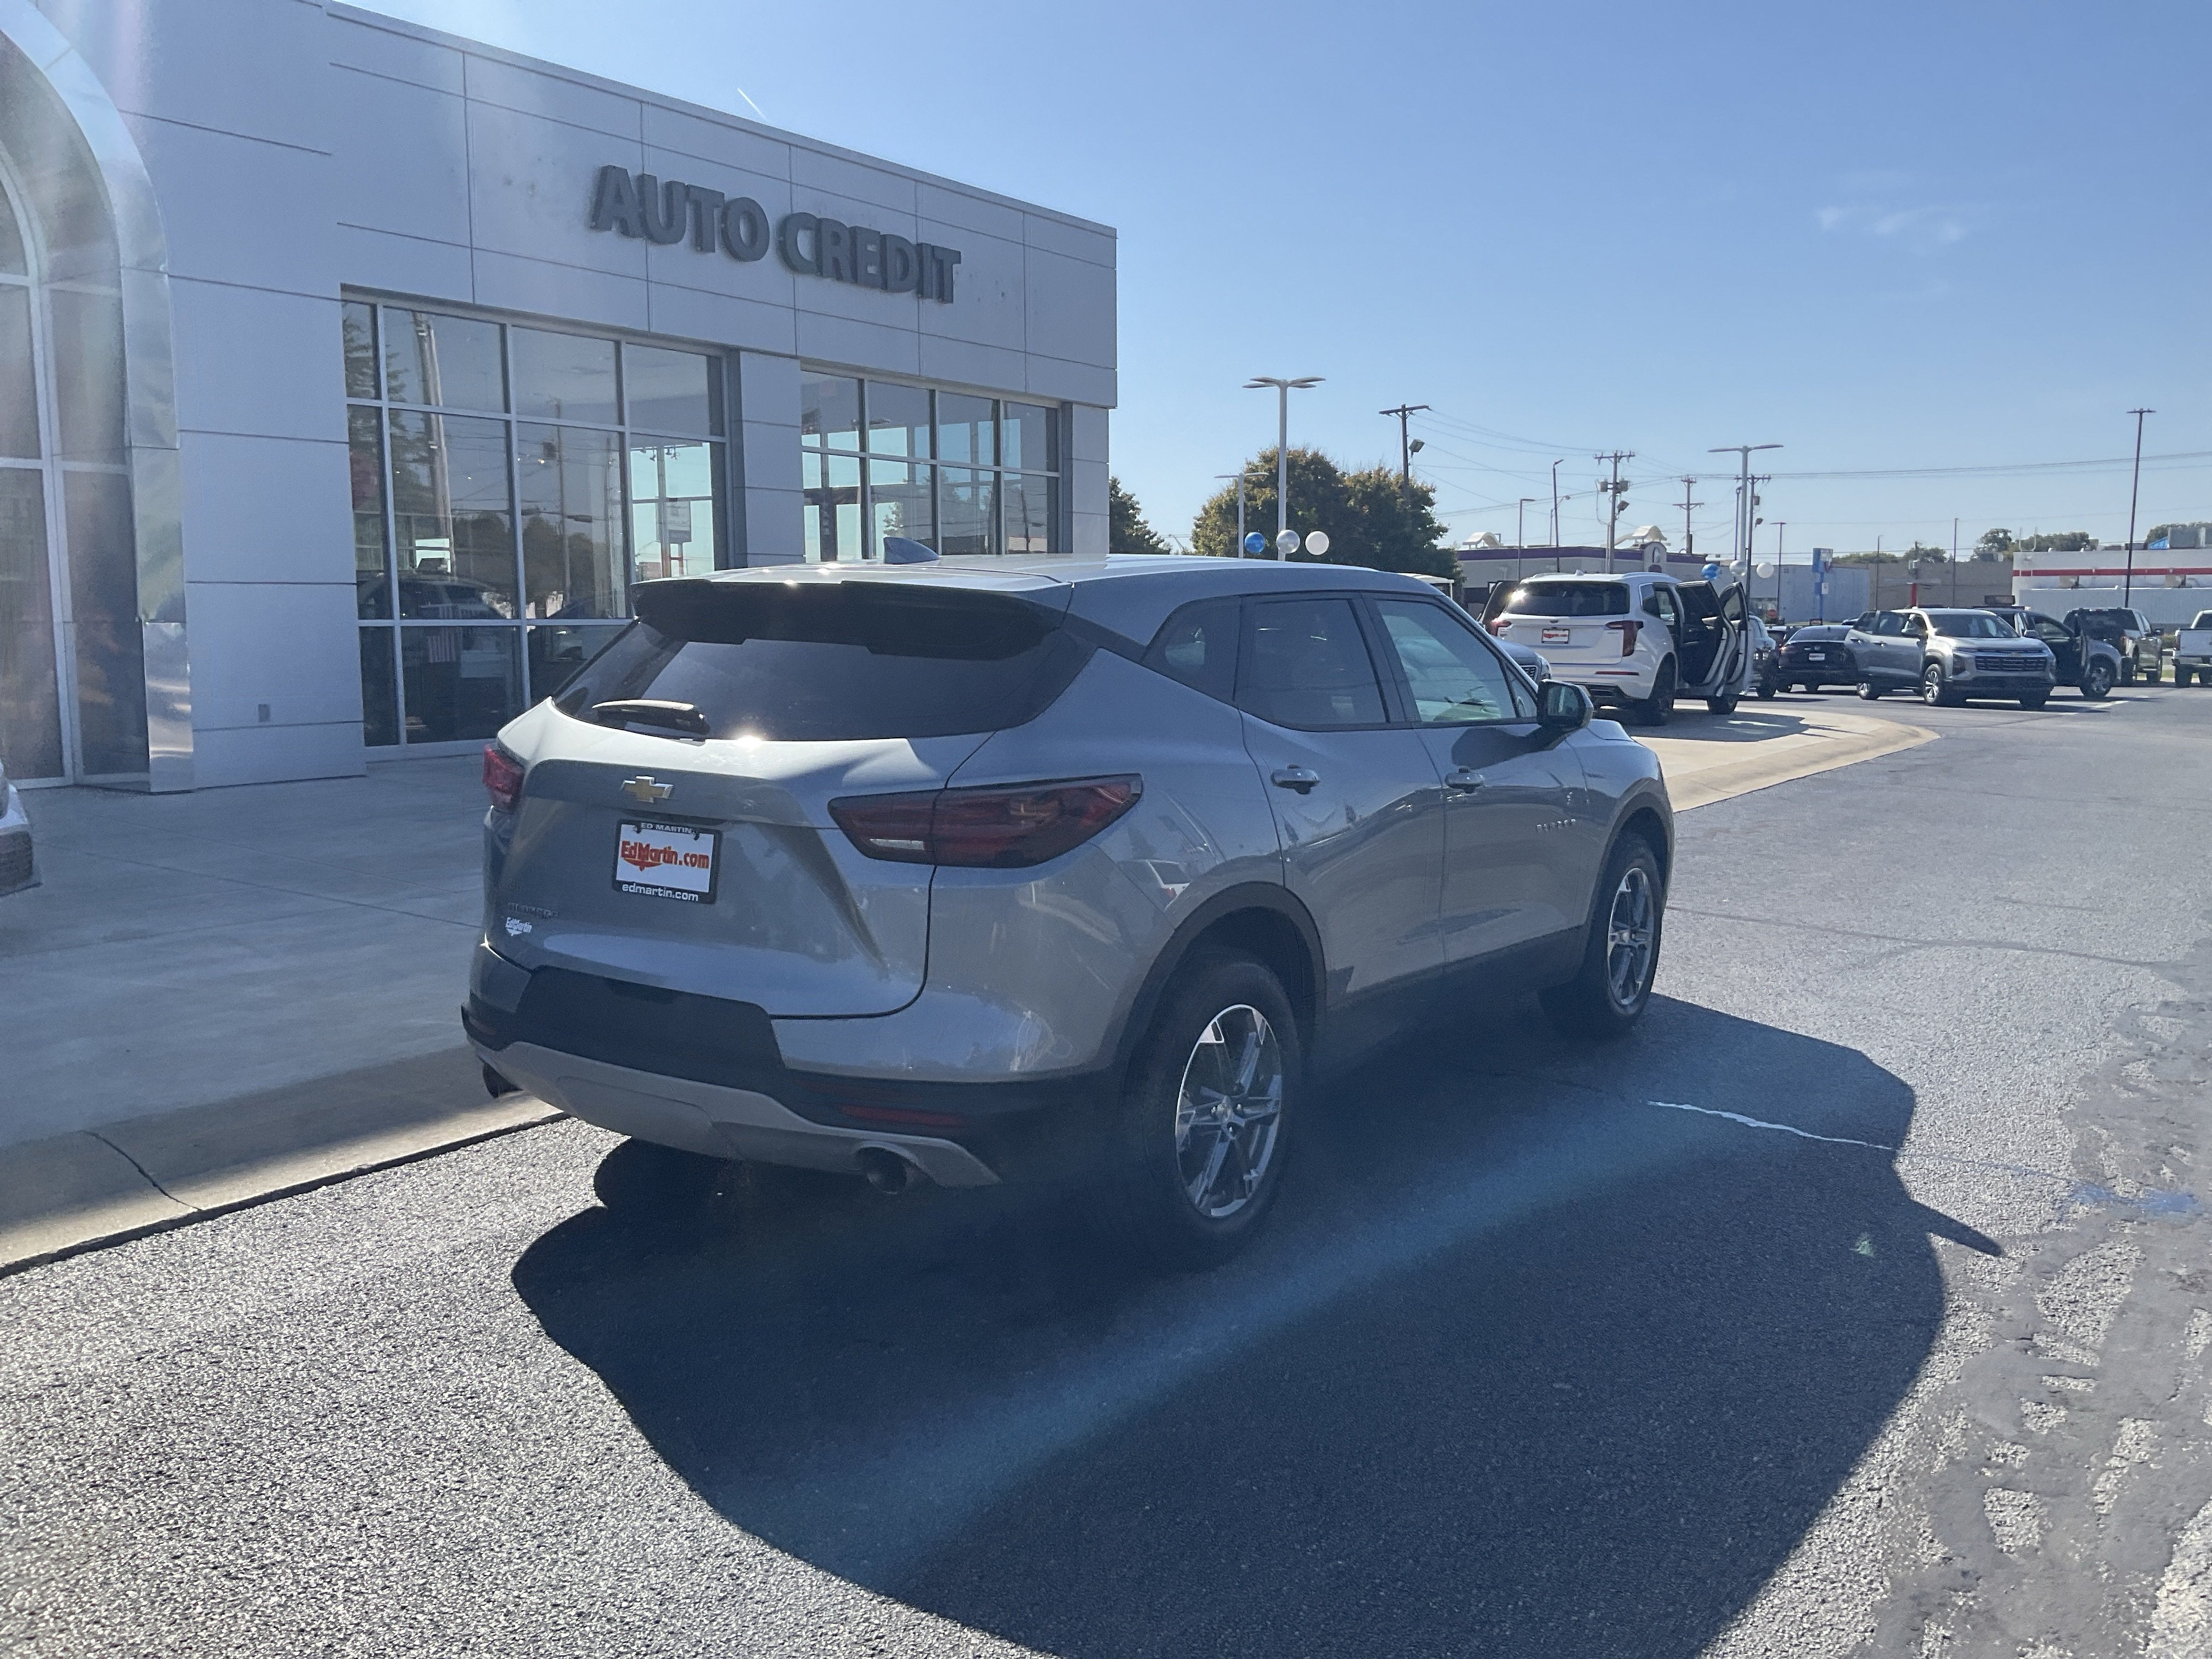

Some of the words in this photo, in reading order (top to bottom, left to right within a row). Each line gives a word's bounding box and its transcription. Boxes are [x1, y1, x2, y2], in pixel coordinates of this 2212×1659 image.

[589, 165, 770, 262] AUTO
[778, 212, 961, 304] CREDIT
[656, 824, 692, 834] MARTIN
[621, 840, 710, 870] EdMartin.com
[622, 883, 698, 901] edmartin.com
